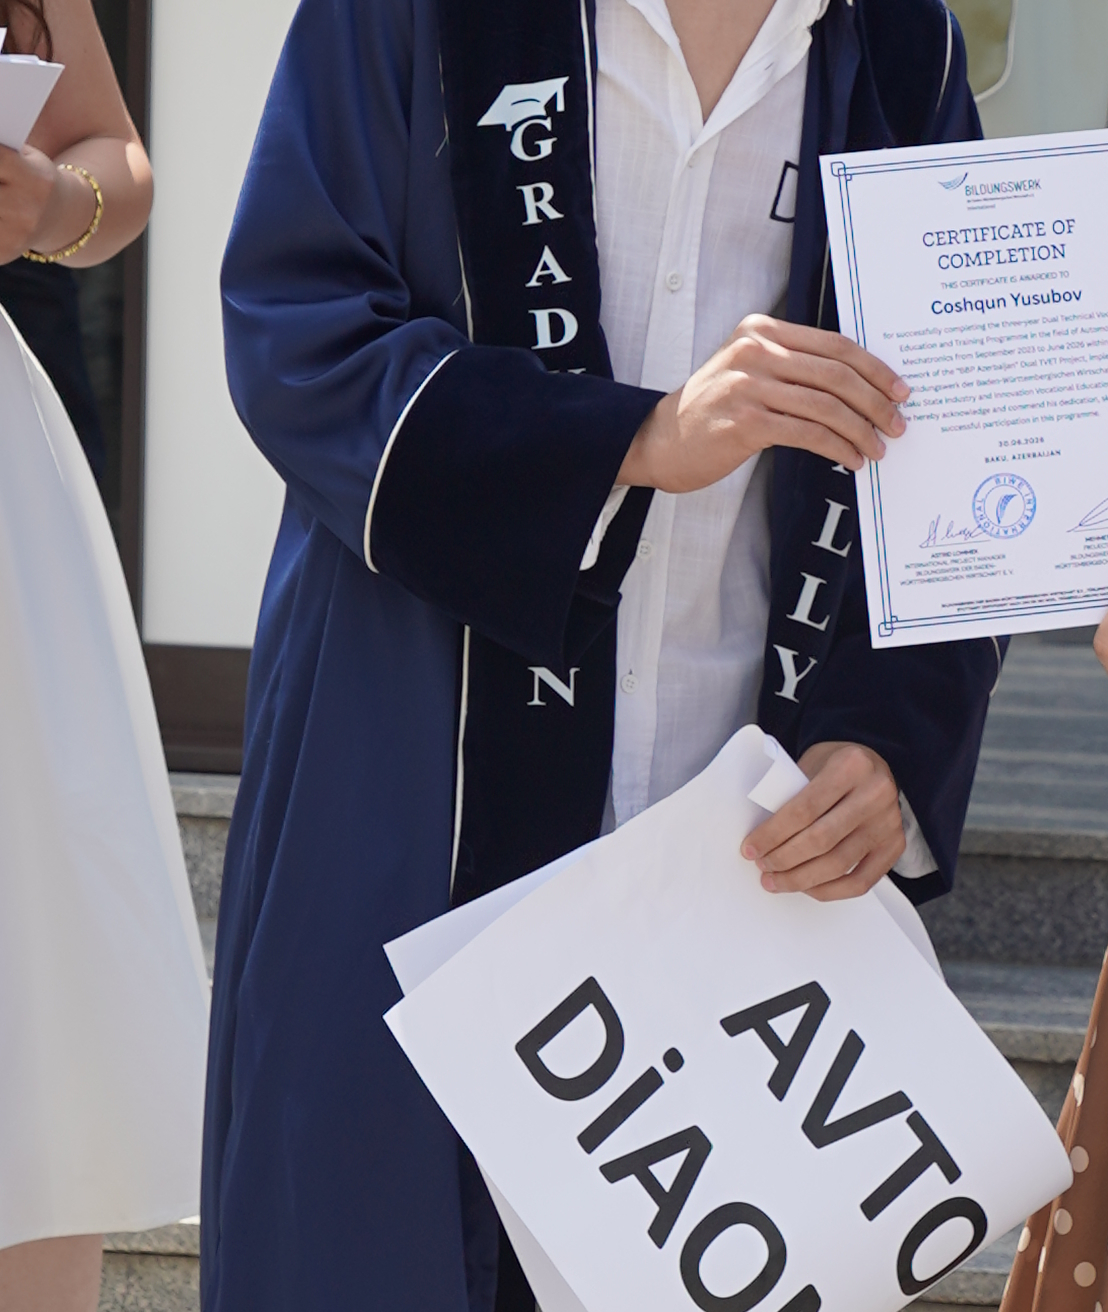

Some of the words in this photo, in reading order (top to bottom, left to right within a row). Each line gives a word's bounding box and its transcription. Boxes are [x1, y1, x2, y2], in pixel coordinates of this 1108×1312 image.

[965, 179, 1041, 196] BILDUNGSWERK
[923, 221, 1046, 247] CERTIFICATE
[1052, 219, 1075, 235] OF
[938, 243, 1066, 270] COMPLETION
[941, 281, 958, 289] THIS
[960, 277, 1007, 288] CERTIFICATE
[1020, 272, 1057, 281] AWARDED
[931, 297, 1006, 315] Coshqun
[1010, 289, 1082, 307] Yusubov
[900, 370, 931, 380] mework
